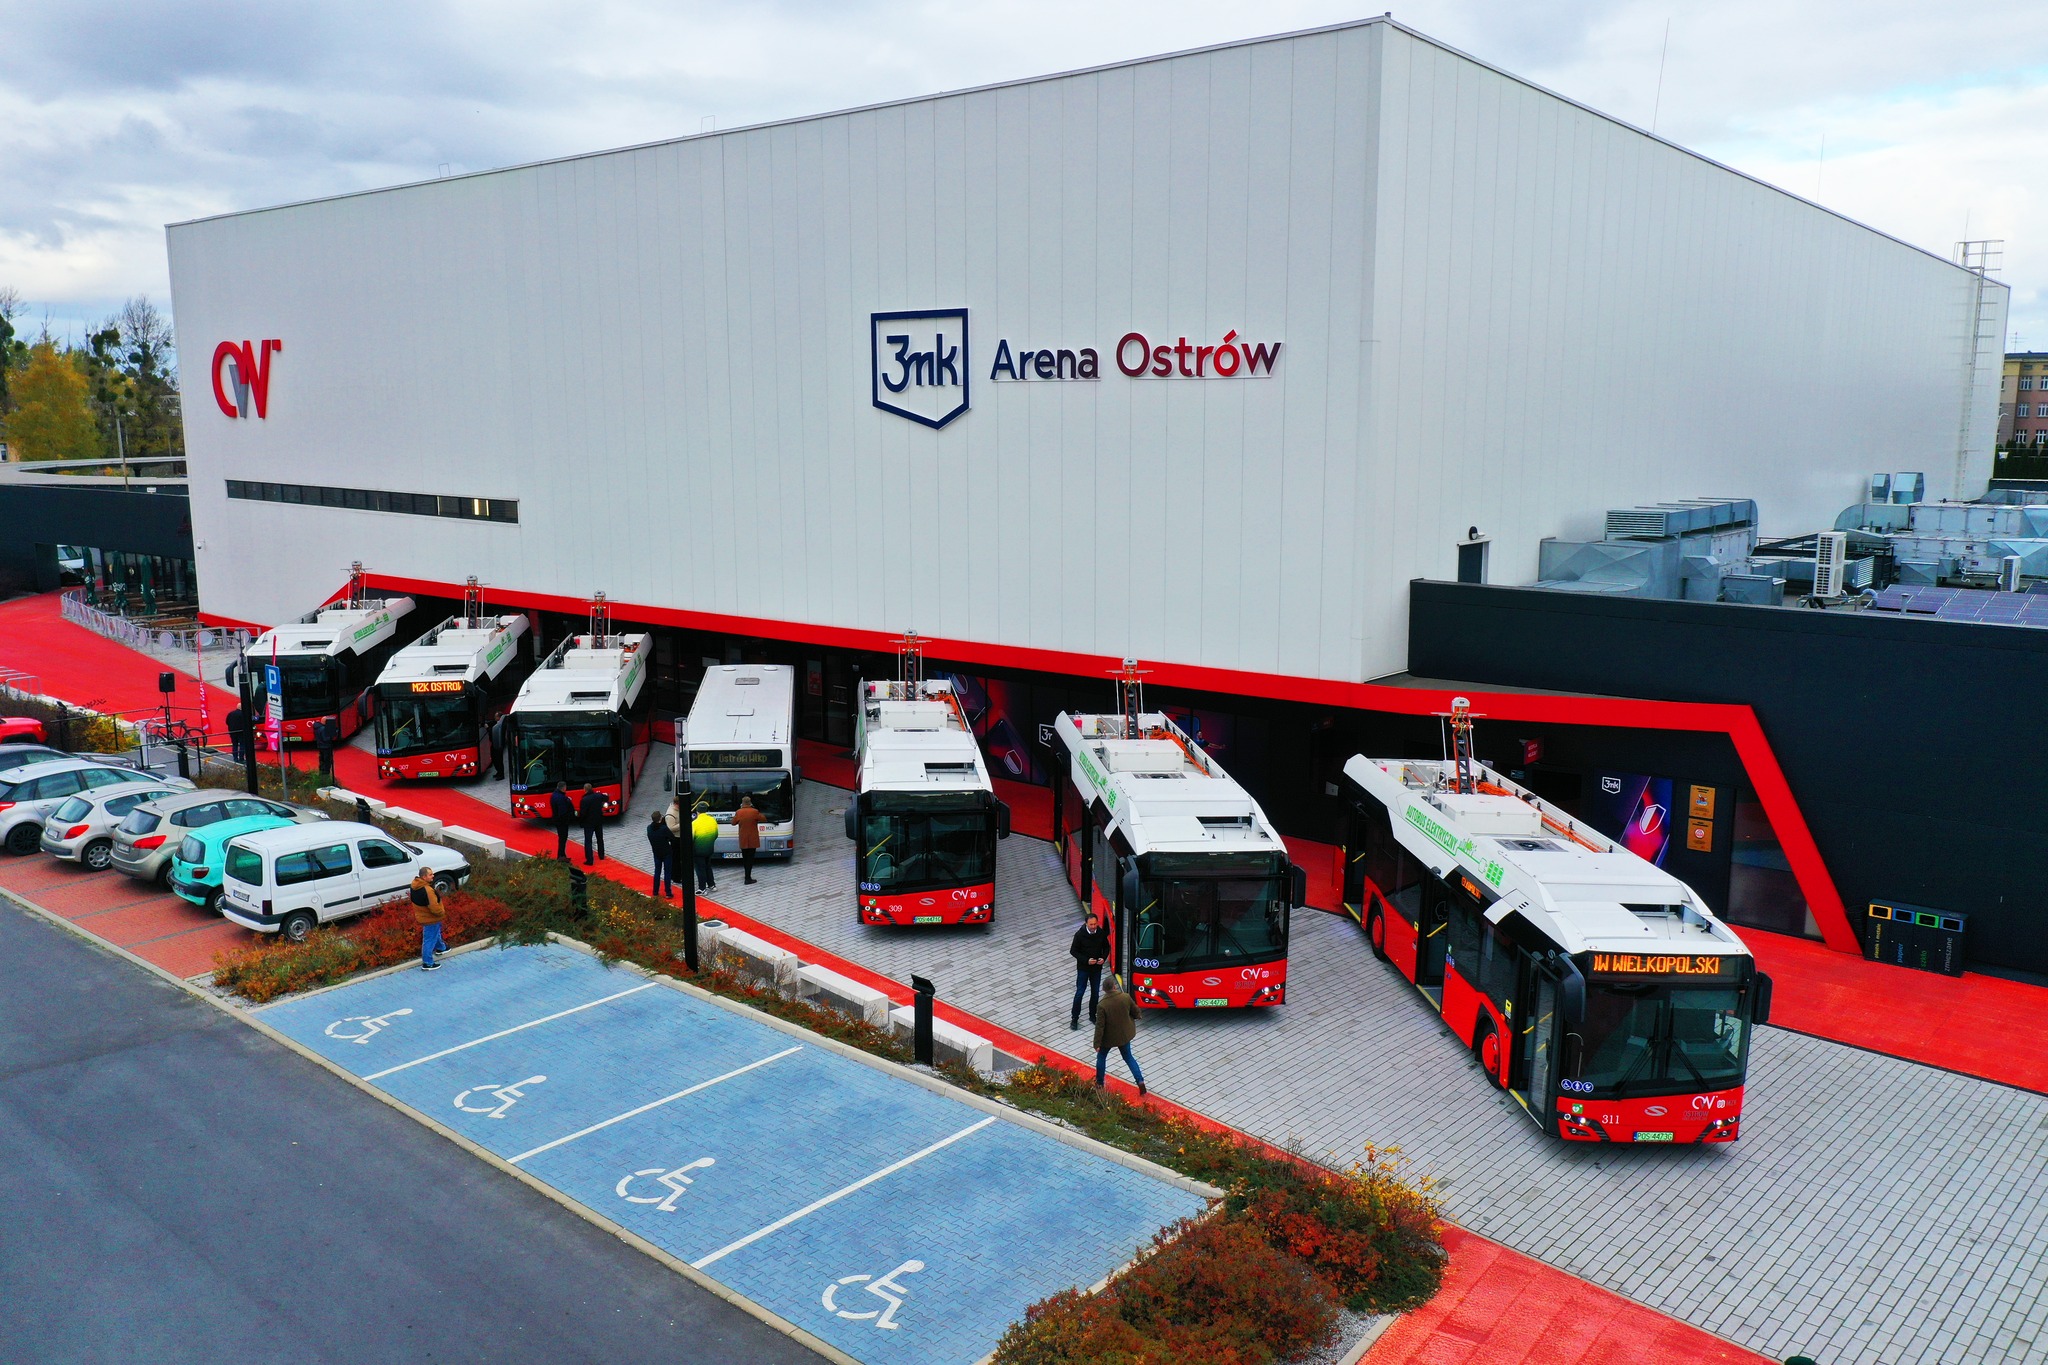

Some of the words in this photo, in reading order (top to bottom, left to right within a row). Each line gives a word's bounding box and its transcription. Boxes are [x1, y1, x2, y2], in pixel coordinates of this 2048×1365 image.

[881, 333, 962, 393] 3mk
[990, 338, 1099, 381] Arena
[1115, 328, 1282, 378] Ostrów
[268, 668, 277, 690] P
[412, 682, 430, 693] MZK
[1612, 954, 1720, 974] WIELKOPOLSKI
[1944, 937, 1953, 972] zmieszane
[1168, 985, 1184, 993] 310
[1601, 1114, 1620, 1124] 311
